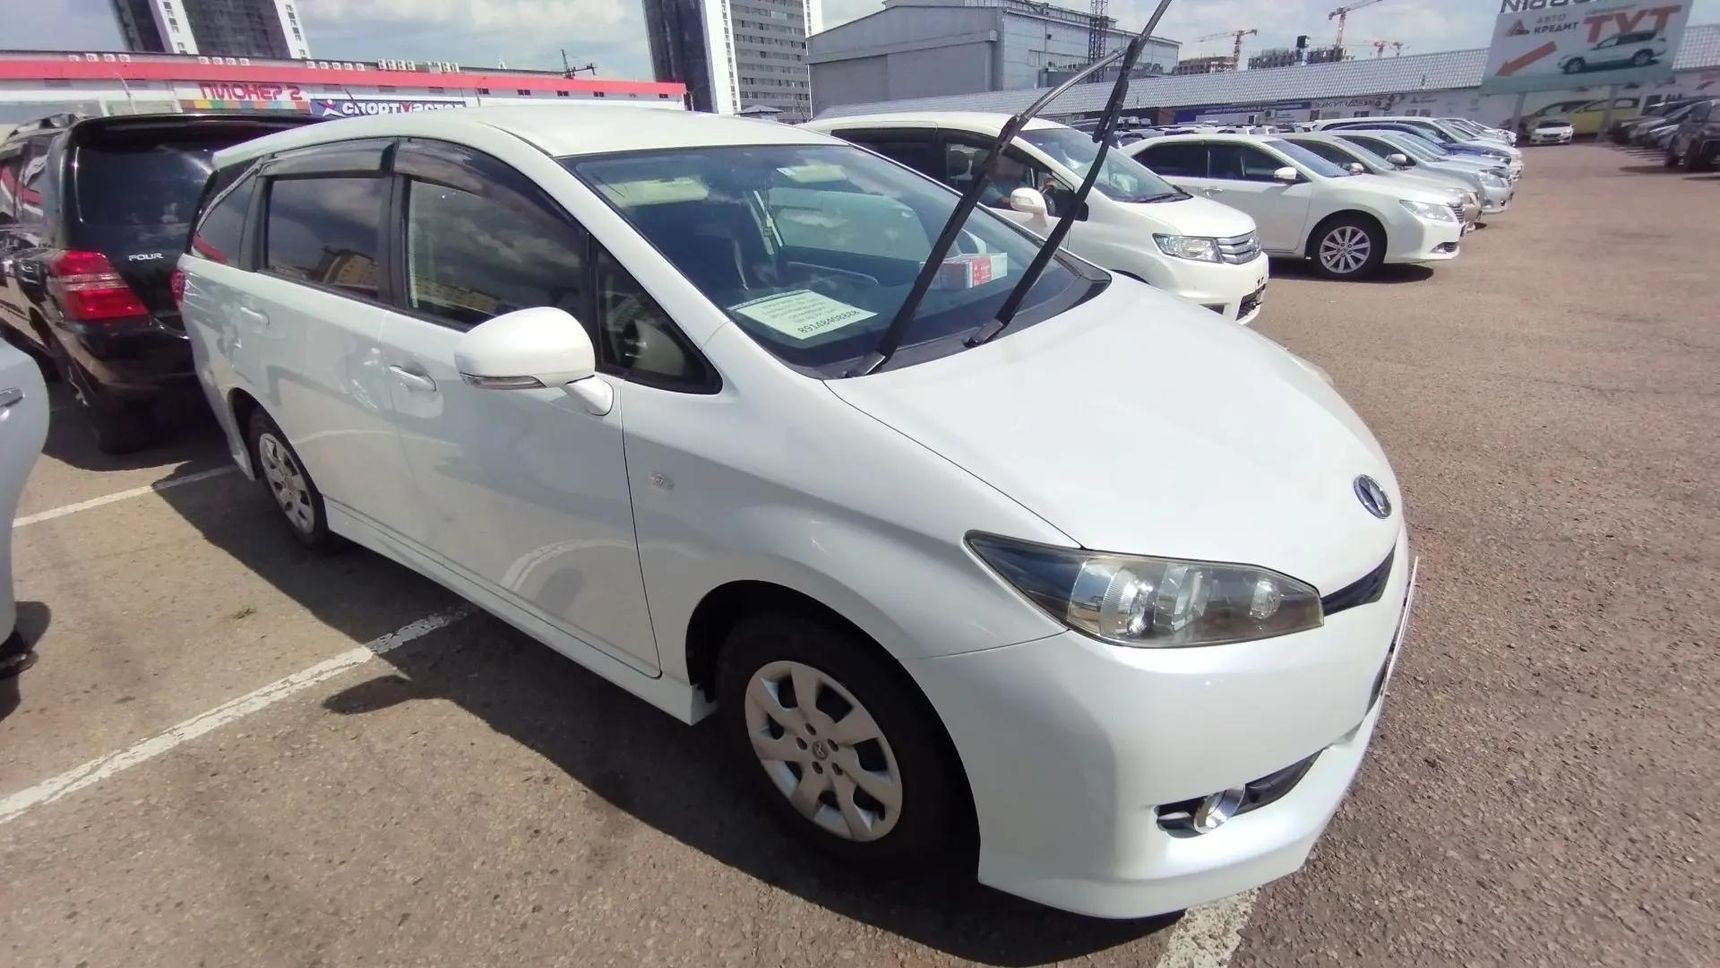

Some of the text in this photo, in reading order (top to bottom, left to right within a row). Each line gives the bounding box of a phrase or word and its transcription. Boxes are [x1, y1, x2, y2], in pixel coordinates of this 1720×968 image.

[1535, 13, 1567, 25] АВТО
[1583, 4, 1683, 44] ТУТ
[1533, 21, 1580, 35] КРЕДИТ
[199, 82, 304, 101] ПИОНЕР 2
[128, 252, 164, 262] FOUR
